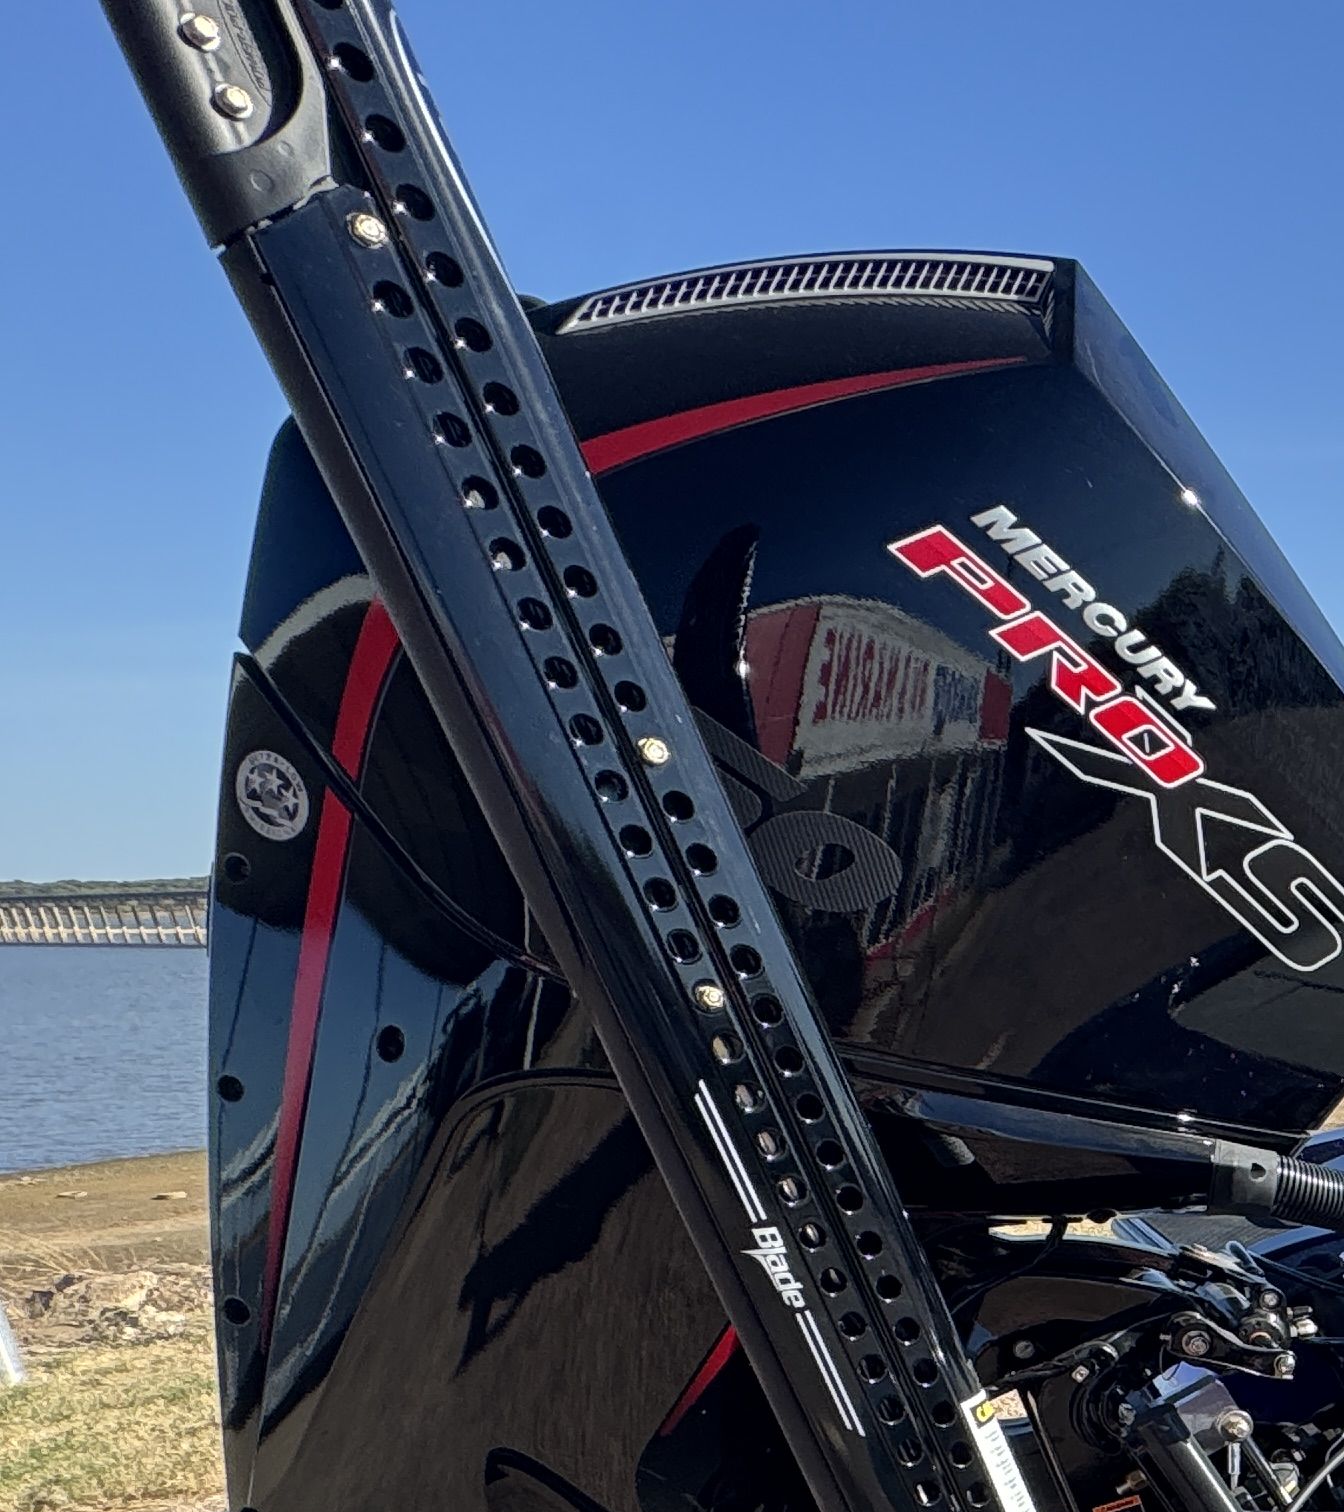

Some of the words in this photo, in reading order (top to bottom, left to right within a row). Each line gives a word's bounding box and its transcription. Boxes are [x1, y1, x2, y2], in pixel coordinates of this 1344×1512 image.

[887, 524, 1206, 788] PRO
[970, 505, 1218, 713] MERCURY
[740, 1226, 806, 1308] Blade
